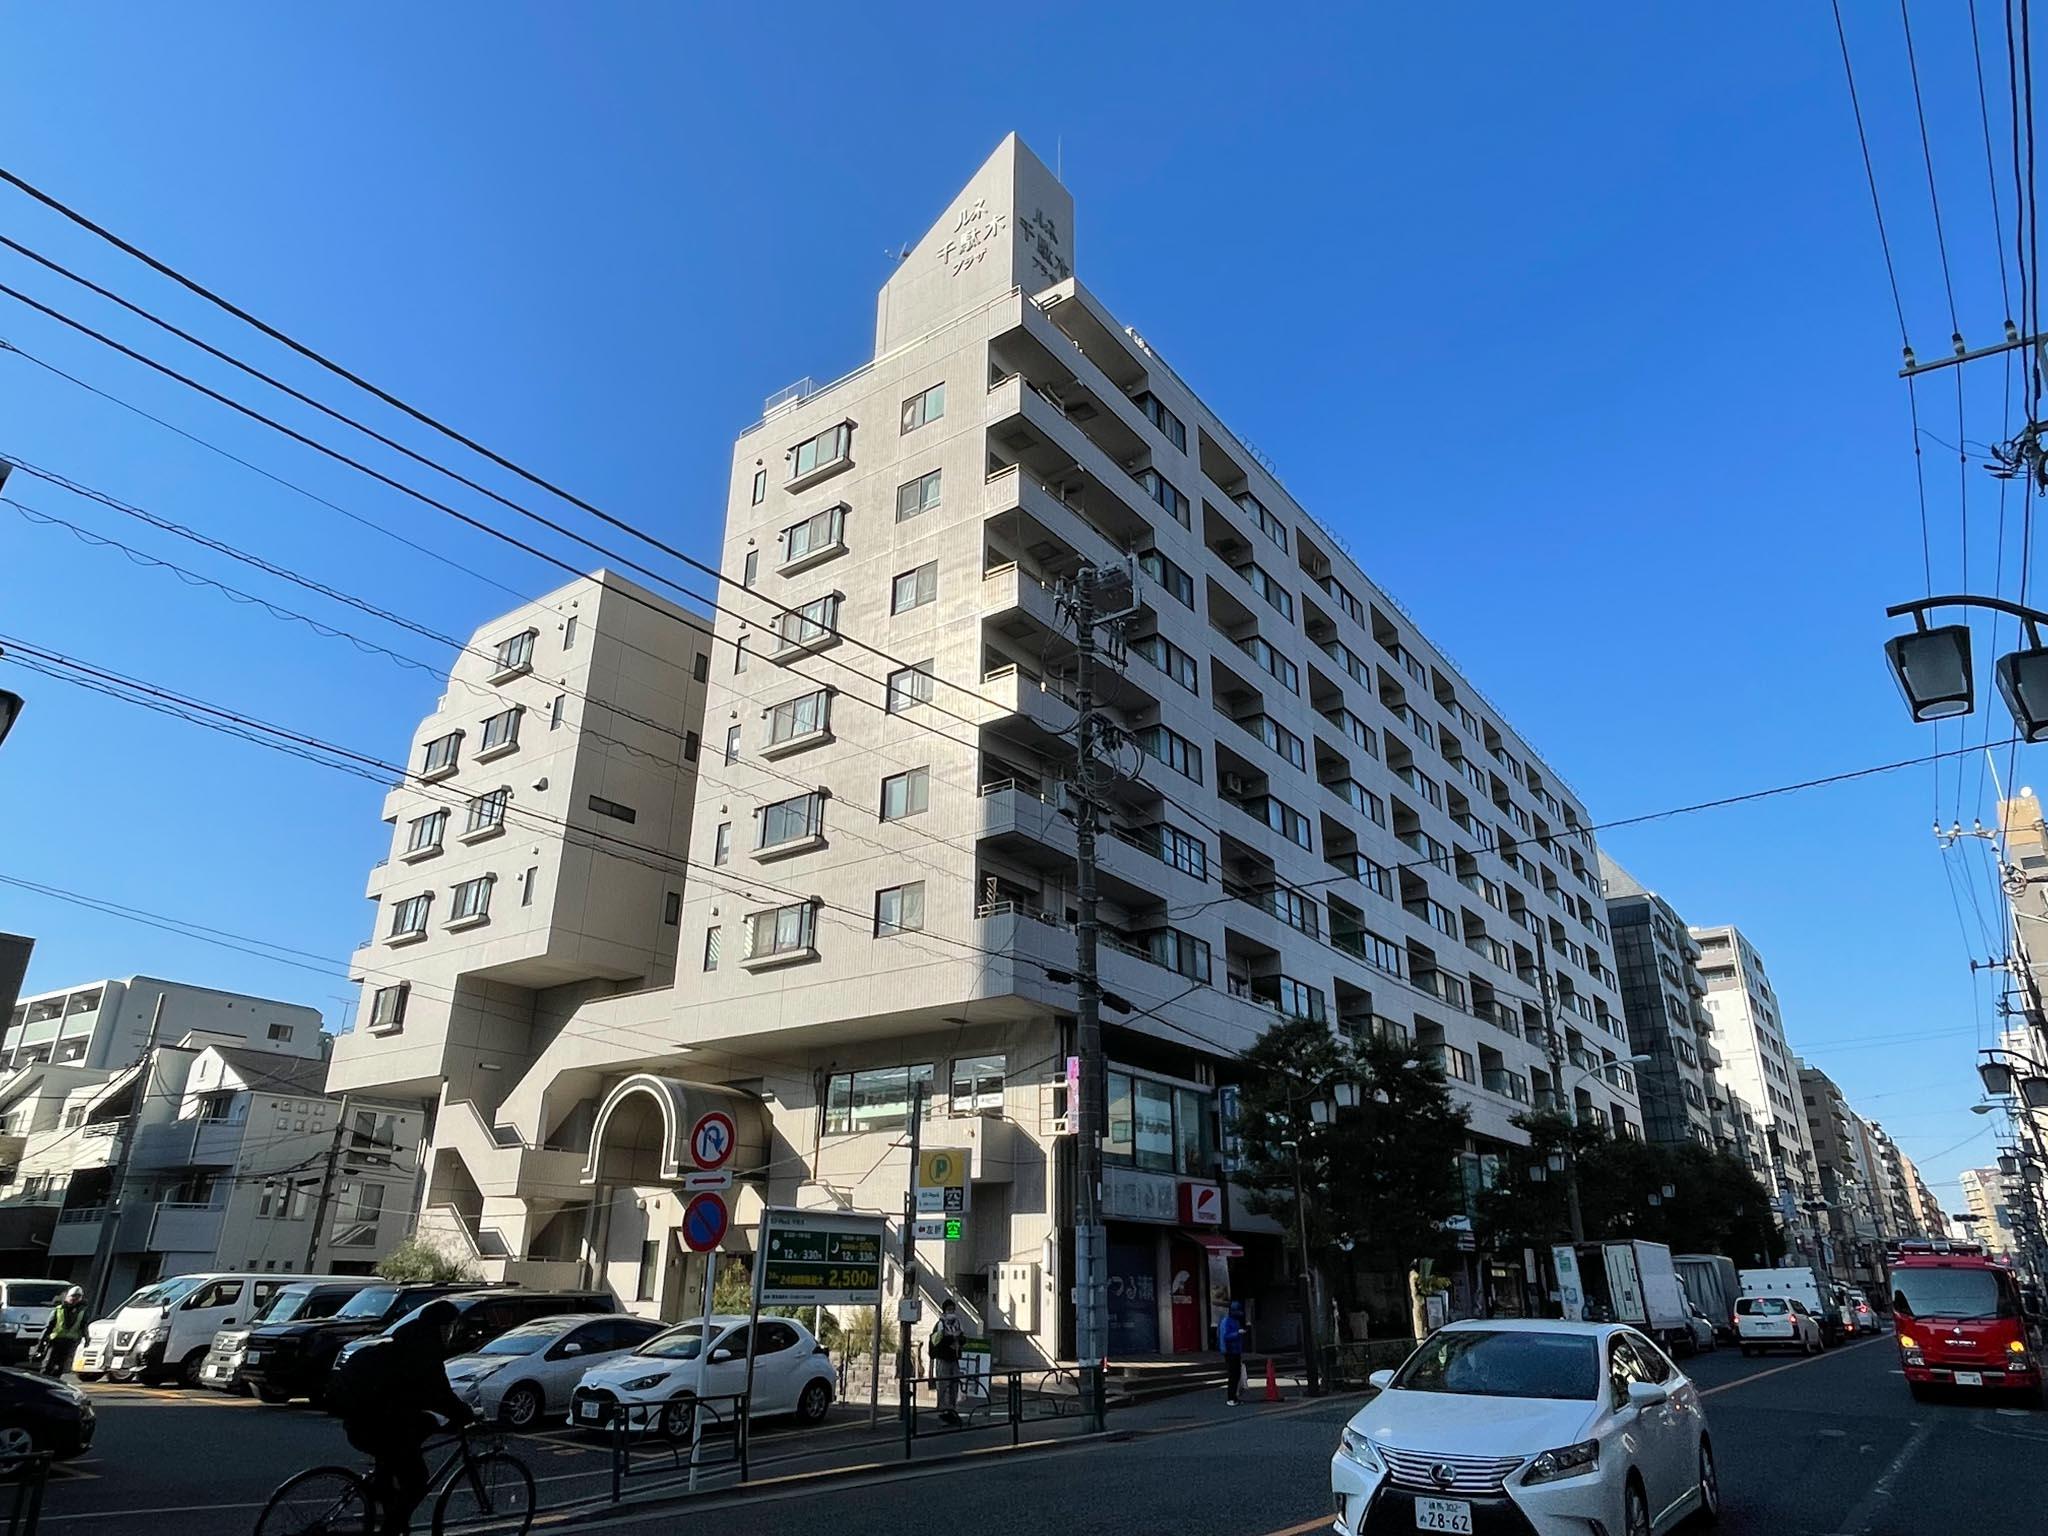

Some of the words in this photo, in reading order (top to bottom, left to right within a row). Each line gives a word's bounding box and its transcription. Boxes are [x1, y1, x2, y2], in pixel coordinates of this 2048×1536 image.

[954, 199, 988, 233] ルネ
[936, 215, 1006, 264] 千駄木
[935, 1159, 948, 1179] P
[946, 1220, 961, 1239] 空
[1428, 1511, 1470, 1532] 28-62
